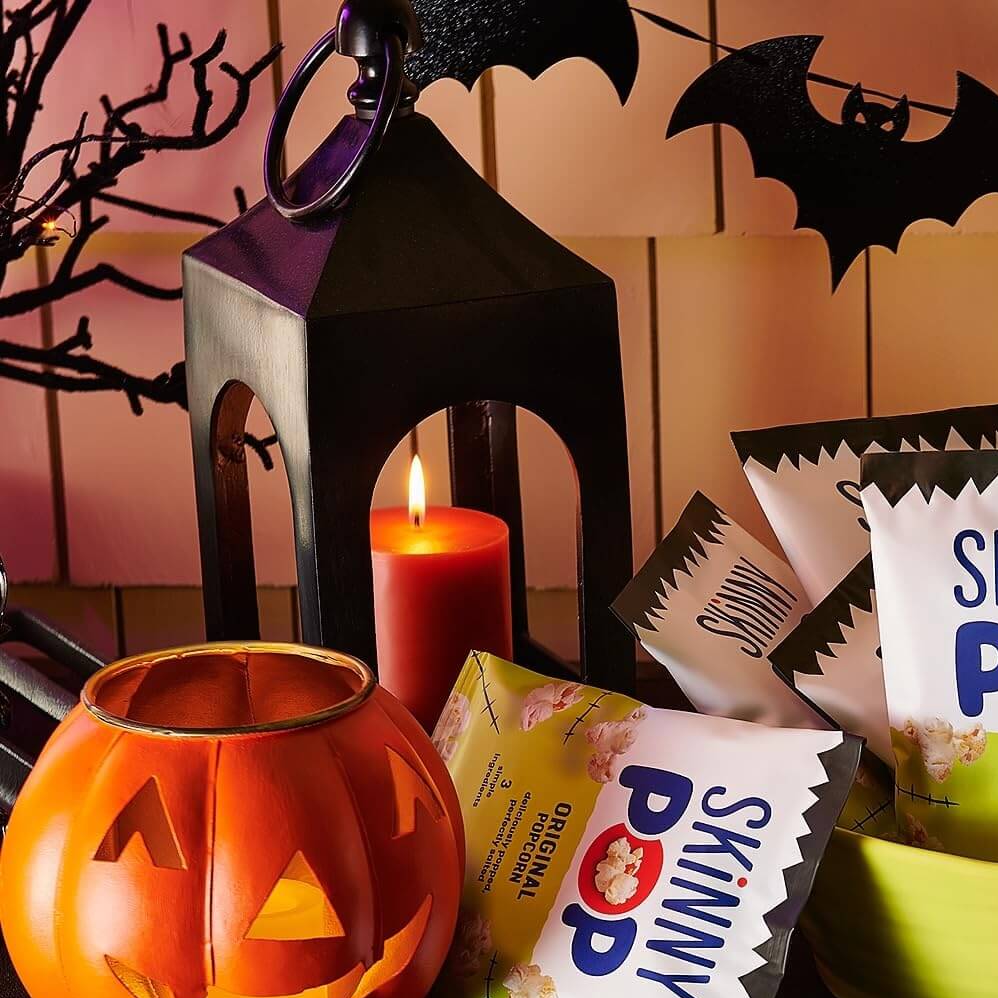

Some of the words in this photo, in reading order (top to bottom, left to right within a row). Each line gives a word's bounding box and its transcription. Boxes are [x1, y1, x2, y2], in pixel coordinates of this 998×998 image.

[472, 753, 501, 807] ingredients
[486, 765, 503, 798] simple
[500, 778, 512, 789] 3
[492, 799, 517, 848] perfectly
[501, 791, 531, 849] deliciously
[477, 849, 496, 882] salted
[482, 850, 505, 894] popped,
[509, 812, 549, 883] POPCORN
[517, 802, 572, 900] ORIGINAL
[562, 764, 693, 977] POP
